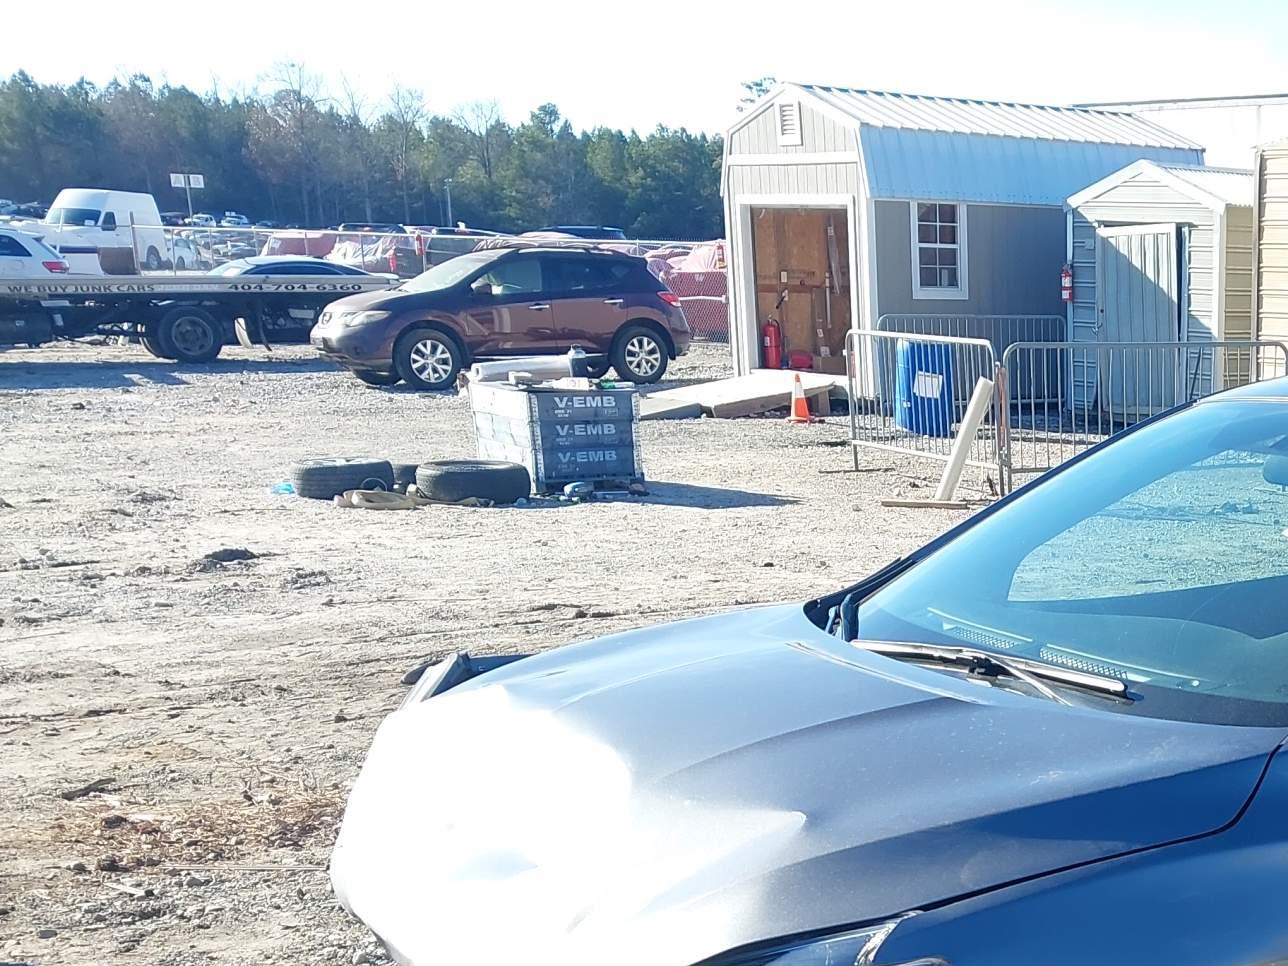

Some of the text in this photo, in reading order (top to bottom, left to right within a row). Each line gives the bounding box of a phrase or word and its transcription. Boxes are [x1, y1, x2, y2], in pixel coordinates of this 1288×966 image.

[7, 284, 155, 294] WE BUY JUNK CARS
[229, 283, 363, 292] 404-704-6360
[553, 396, 616, 408] V-EMB
[555, 423, 616, 436] V-EMB
[558, 450, 617, 463] V-EMB
